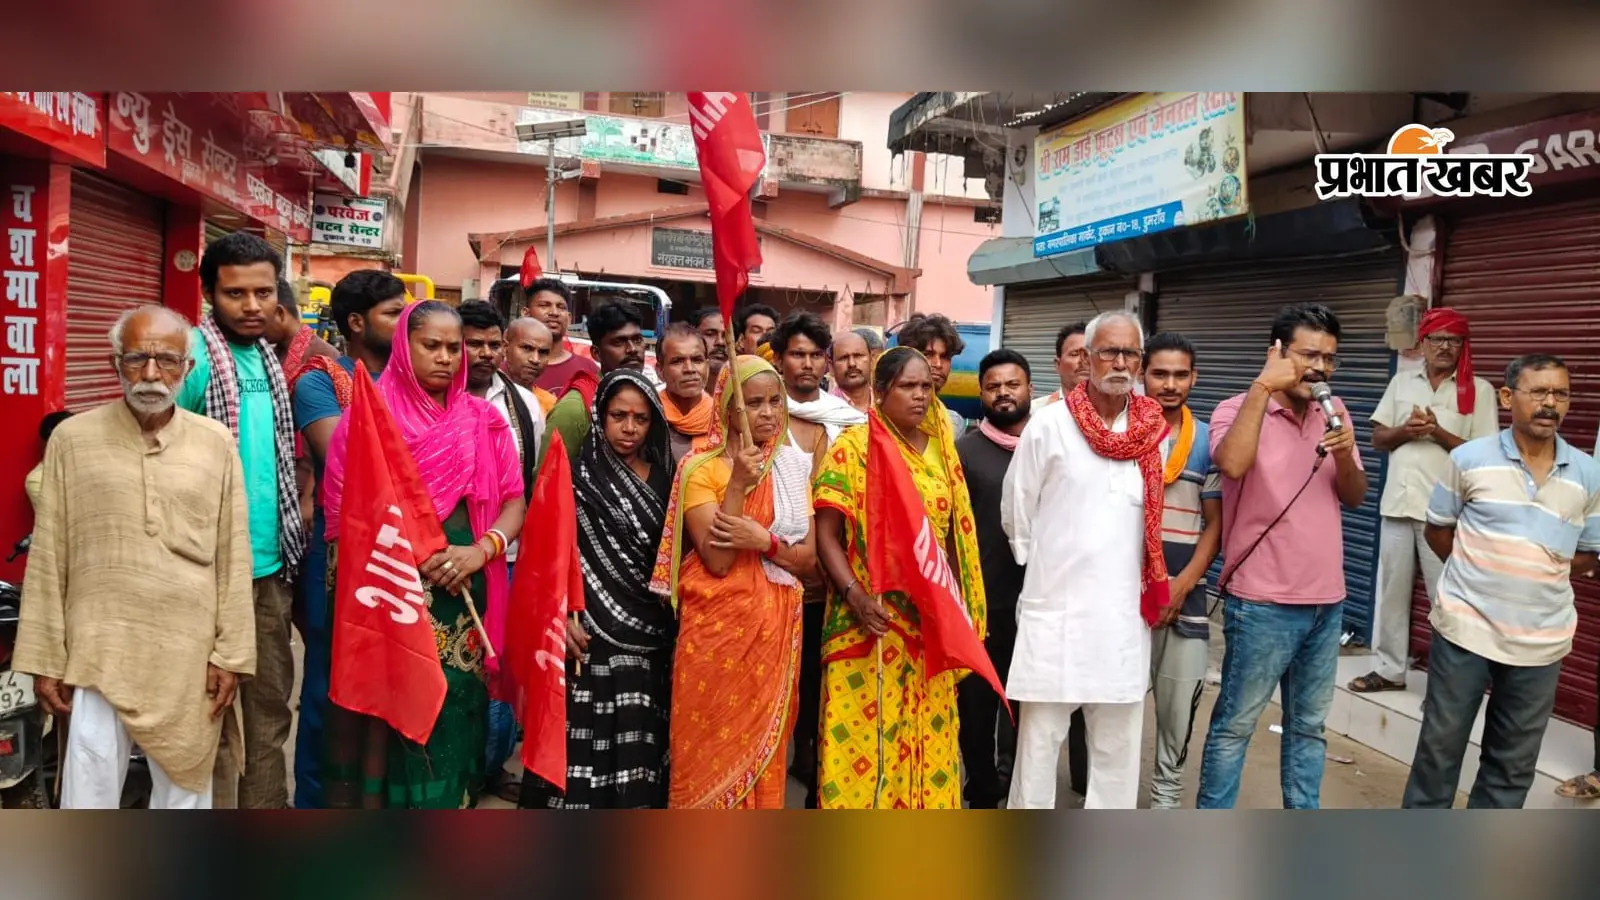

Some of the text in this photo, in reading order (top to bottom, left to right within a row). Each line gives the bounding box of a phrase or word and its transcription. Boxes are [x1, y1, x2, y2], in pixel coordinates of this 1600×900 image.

[1054, 145, 1070, 169] राम
[1513, 128, 1600, 174] GAR
[327, 205, 371, 221] परवेज
[314, 220, 381, 237] बटन सेन्टर
